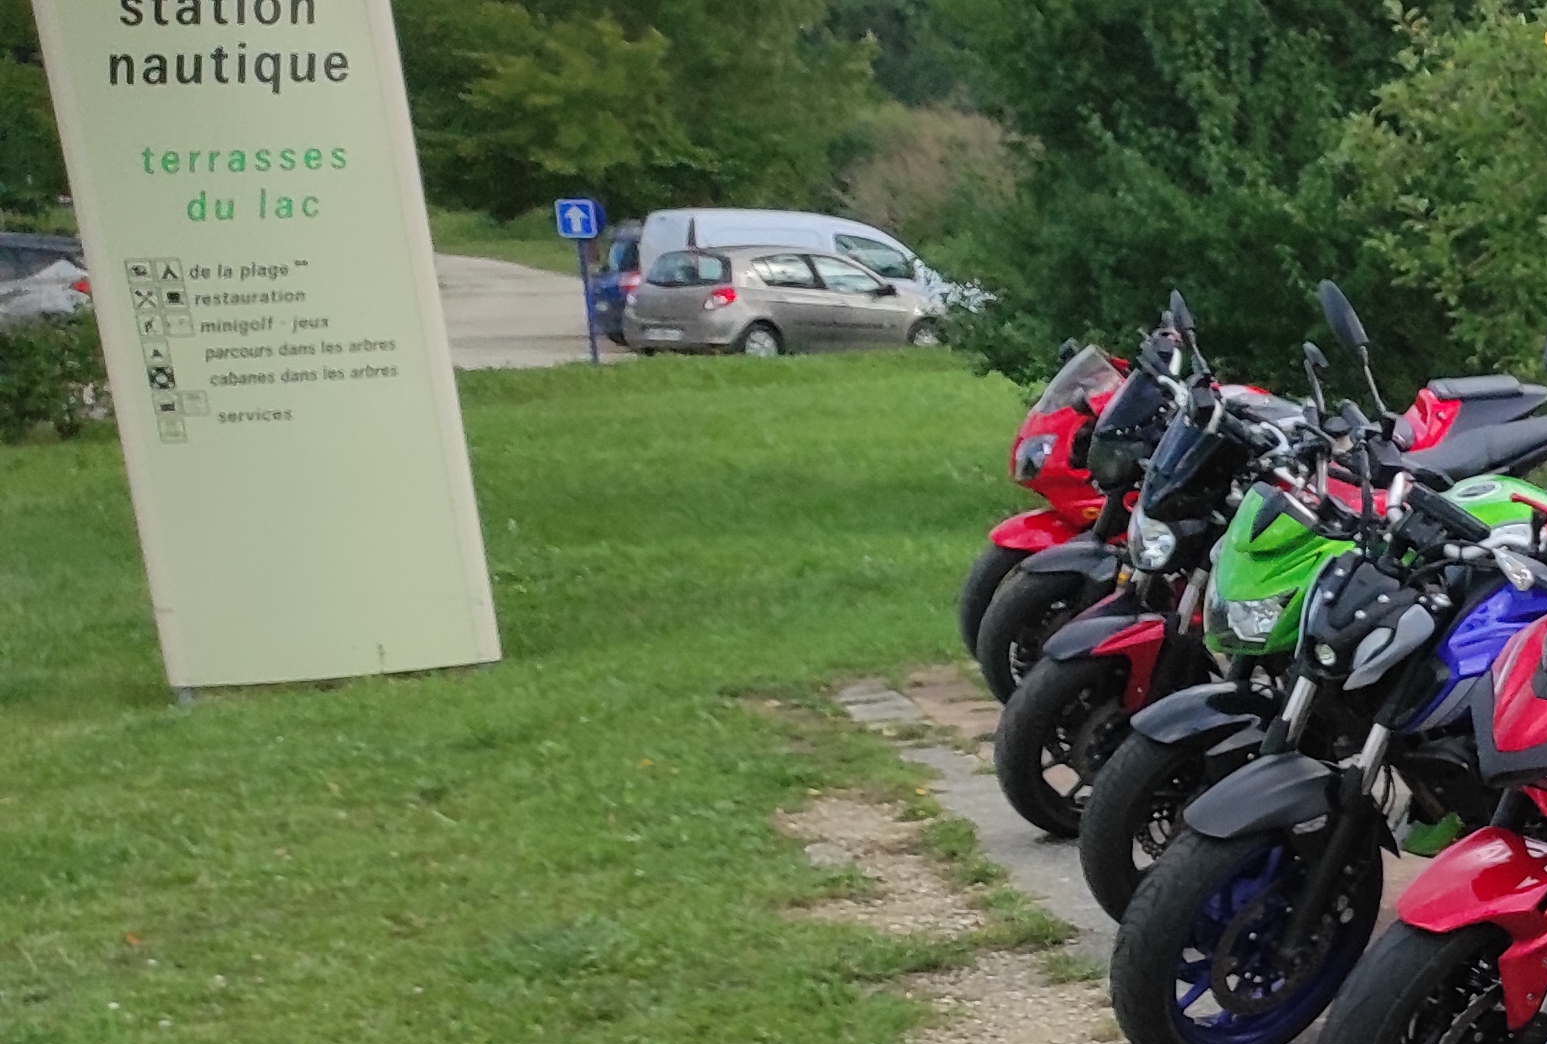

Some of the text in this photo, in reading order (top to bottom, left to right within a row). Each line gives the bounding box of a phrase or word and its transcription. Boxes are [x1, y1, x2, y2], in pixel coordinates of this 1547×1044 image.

[120, 0, 315, 25] station
[109, 42, 350, 94] nautique
[142, 147, 347, 174] terrasses
[187, 188, 319, 221] du lac
[189, 264, 211, 280] de
[218, 263, 233, 279] la
[240, 262, 289, 281] plage
[194, 290, 306, 306] restauration
[200, 316, 273, 336] minigolf
[205, 339, 396, 362] parcours dans les arbres
[210, 365, 398, 387] cabanes dans les arbres
[218, 408, 293, 424] services
